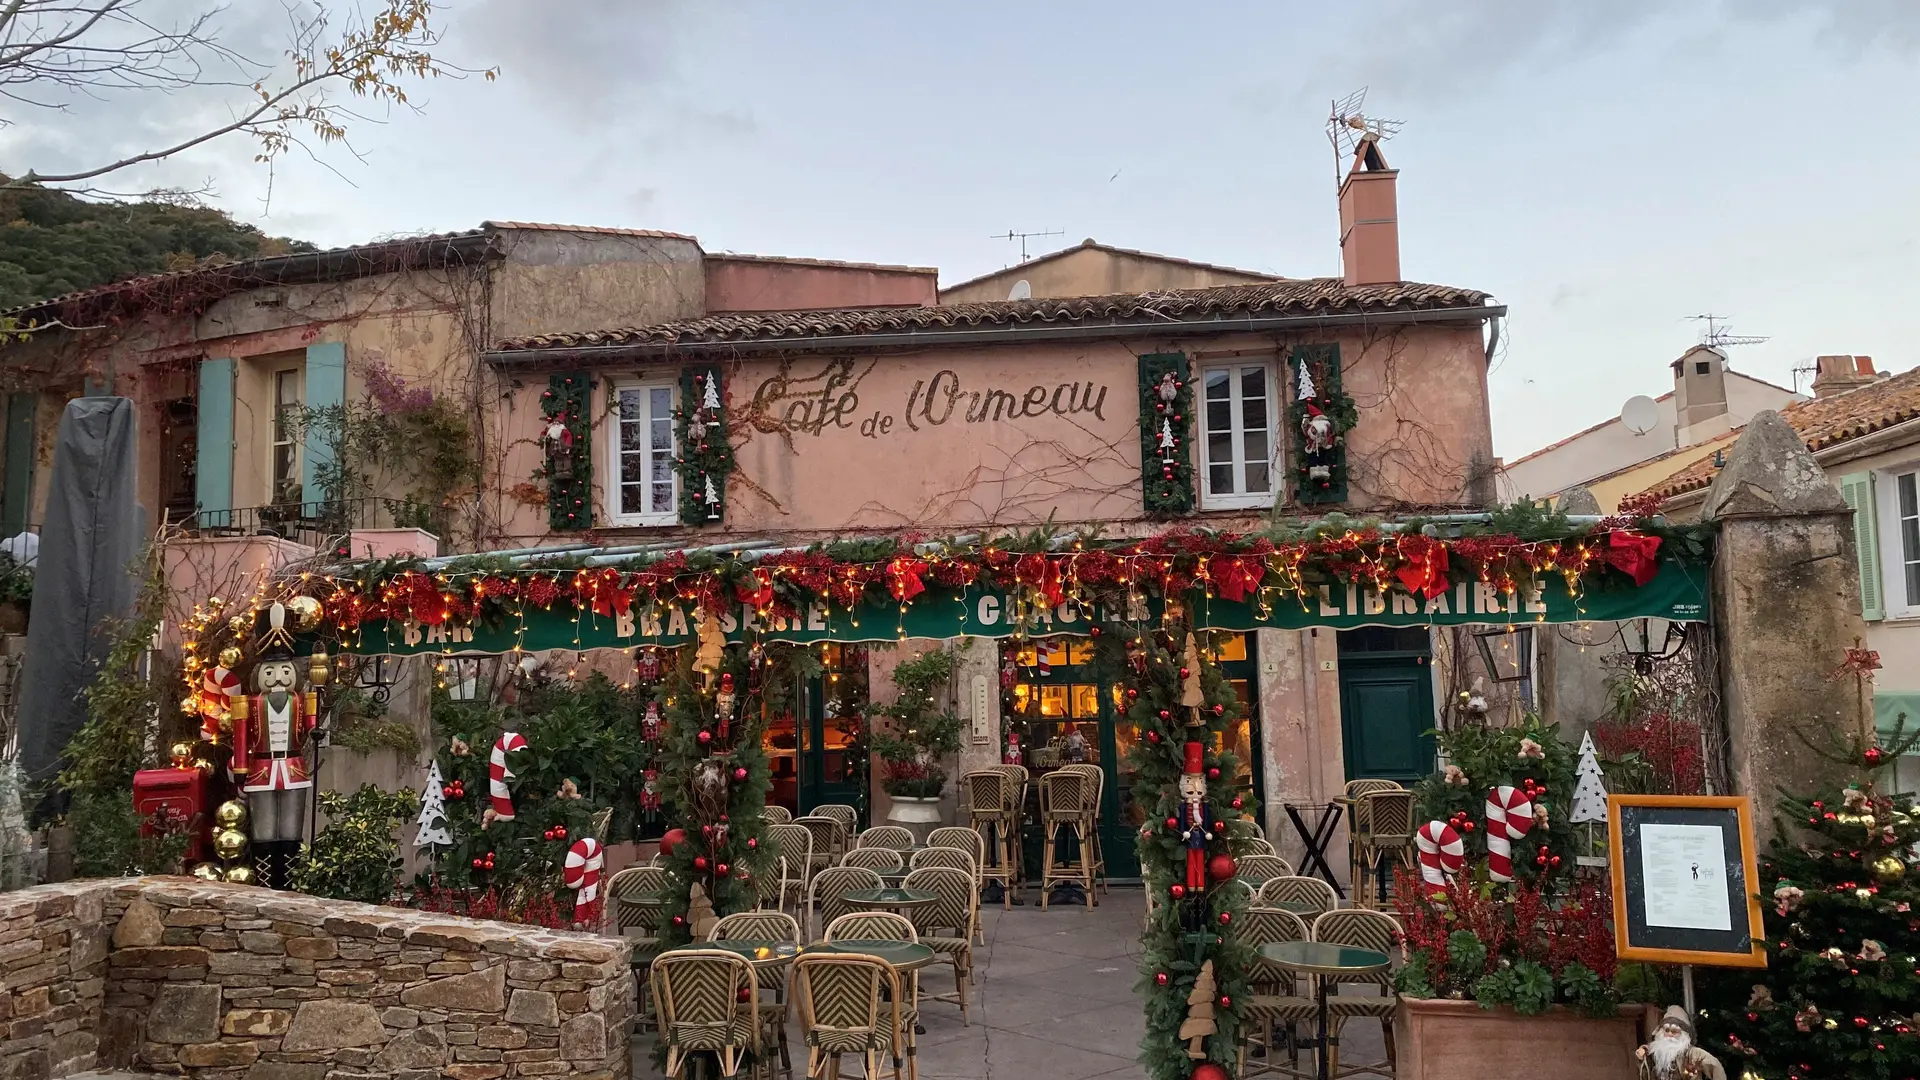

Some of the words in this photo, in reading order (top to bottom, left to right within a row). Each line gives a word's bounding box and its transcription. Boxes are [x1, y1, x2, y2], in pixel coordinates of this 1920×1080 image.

[860, 411, 893, 439] de
[404, 617, 474, 645] BAR
[1319, 581, 1547, 617] LIBRAIRIE
